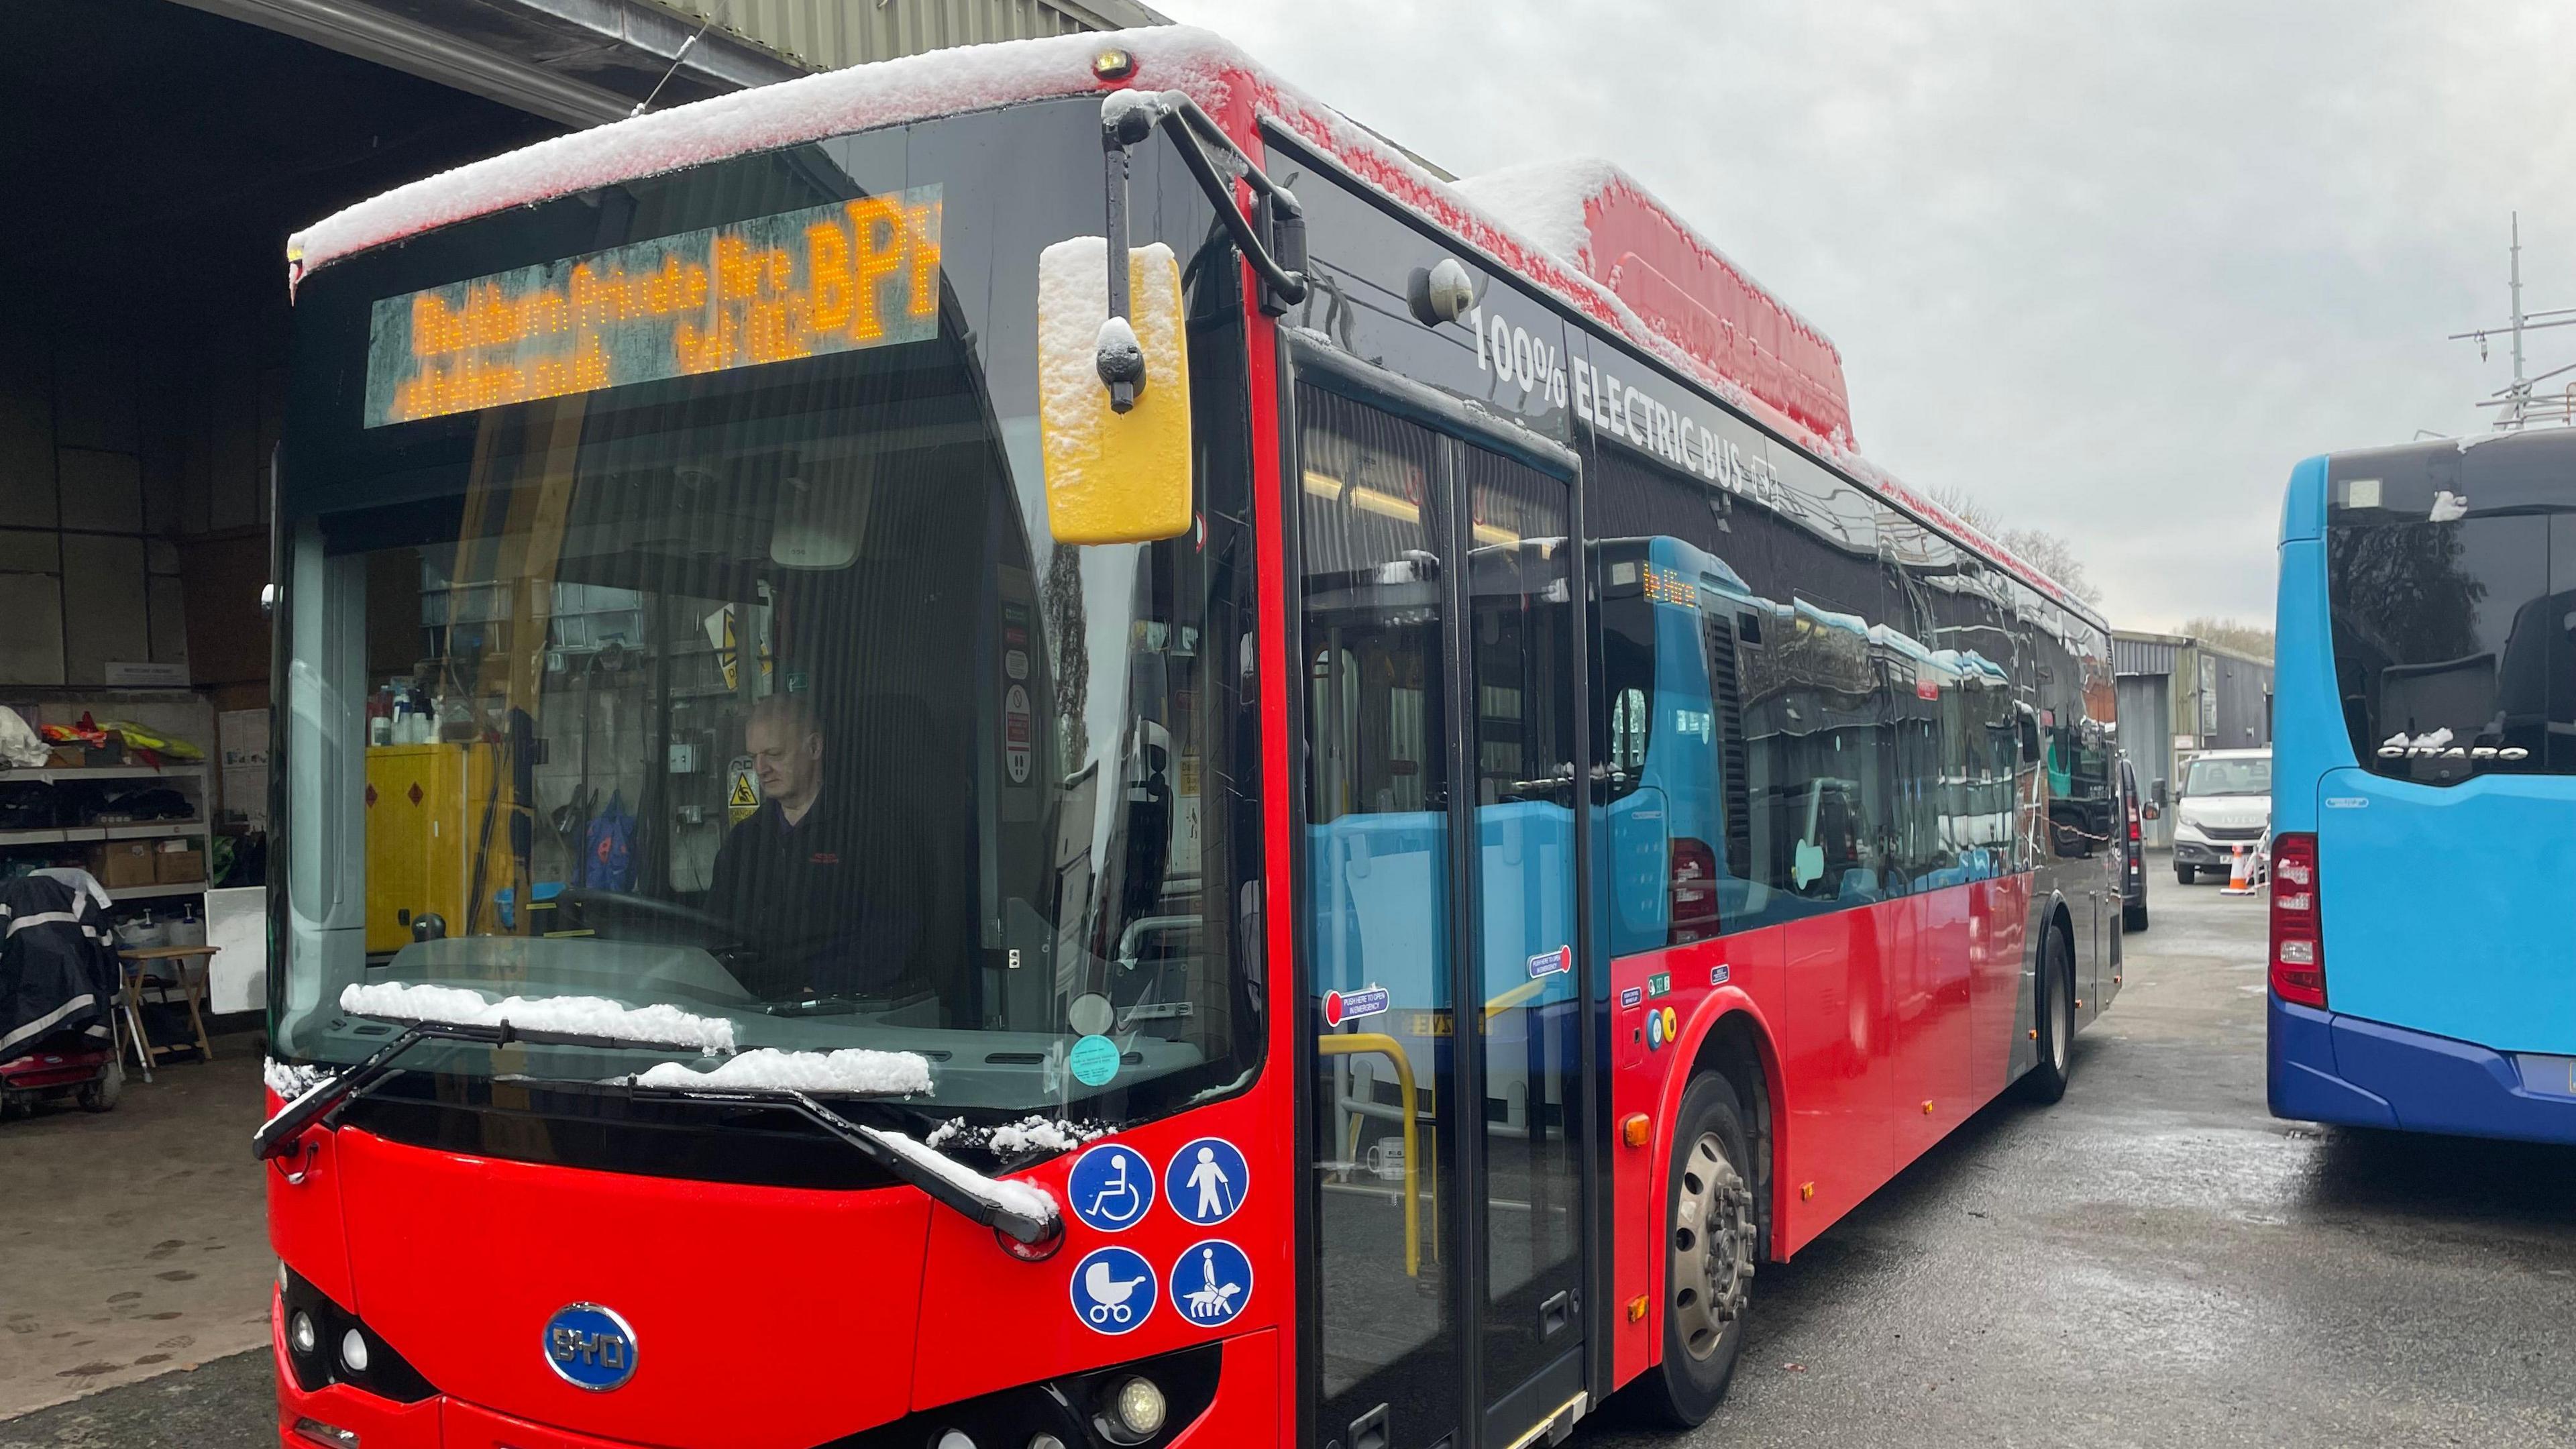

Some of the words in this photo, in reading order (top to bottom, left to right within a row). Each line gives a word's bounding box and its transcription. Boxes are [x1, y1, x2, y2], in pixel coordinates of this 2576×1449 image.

[576, 260, 706, 327] Private
[720, 239, 792, 301] Hire
[1470, 305, 1566, 409] 100%
[1573, 356, 1697, 472] ELECTRIC
[1700, 425, 1742, 494] BUS
[1663, 568, 1695, 608] Hire
[2377, 747, 2529, 760] CITARO
[1344, 998, 1355, 1006] PUSH
[1356, 996, 1367, 1004] HERE
[1367, 994, 1373, 1002] TO
[1373, 992, 1385, 1001] OPEN
[1354, 1002, 1380, 1014] EMERGENCY
[552, 1327, 625, 1369] BYD
